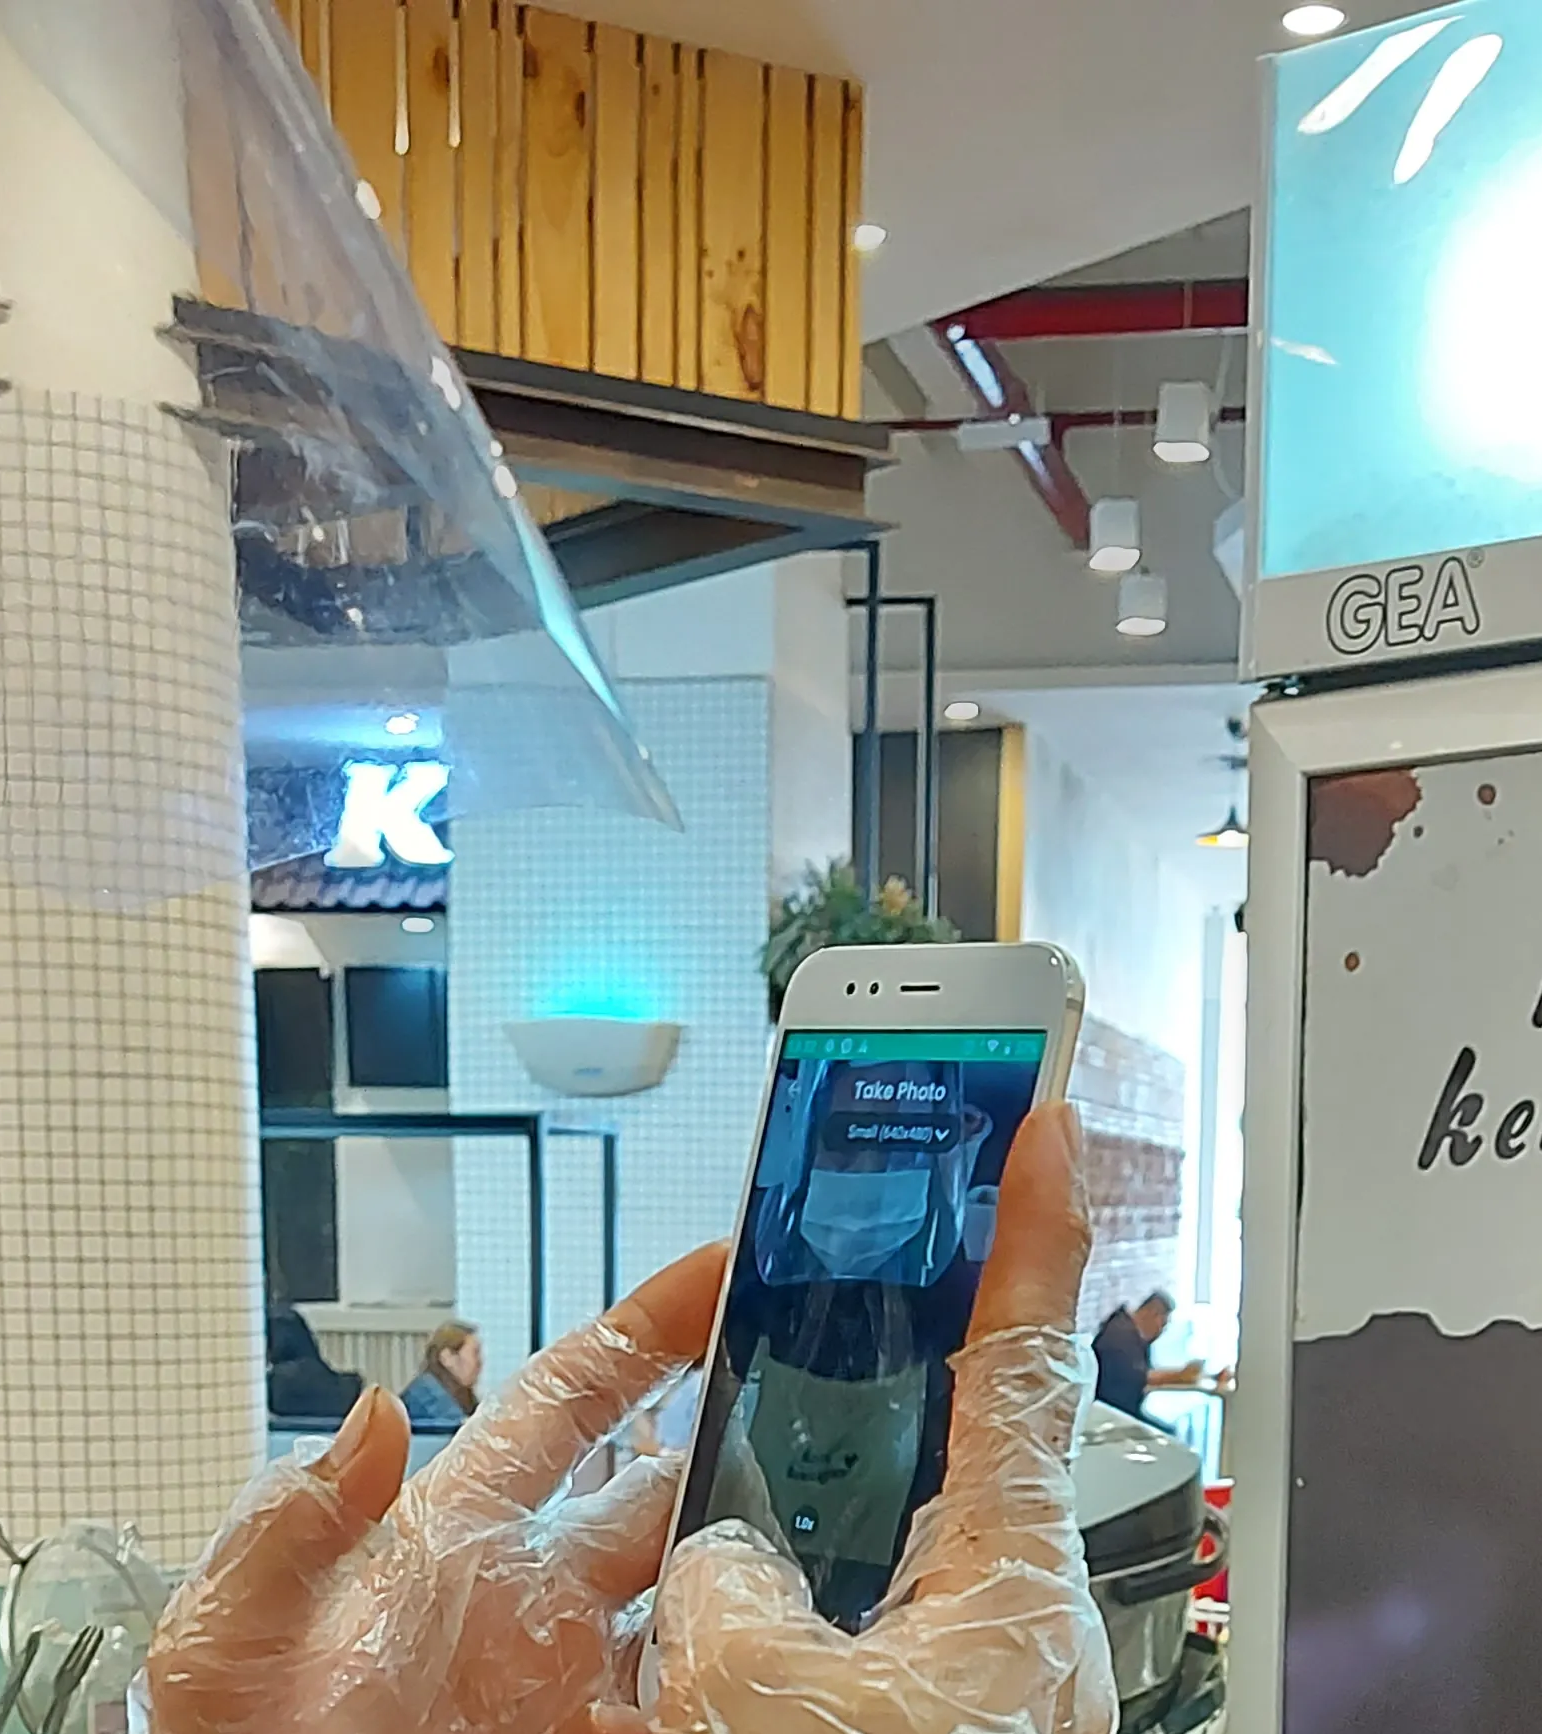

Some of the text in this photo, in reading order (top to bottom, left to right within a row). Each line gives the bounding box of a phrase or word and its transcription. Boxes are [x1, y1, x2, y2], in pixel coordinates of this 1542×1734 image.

[324, 760, 455, 868] K
[854, 1081, 946, 1102] Take Photo
